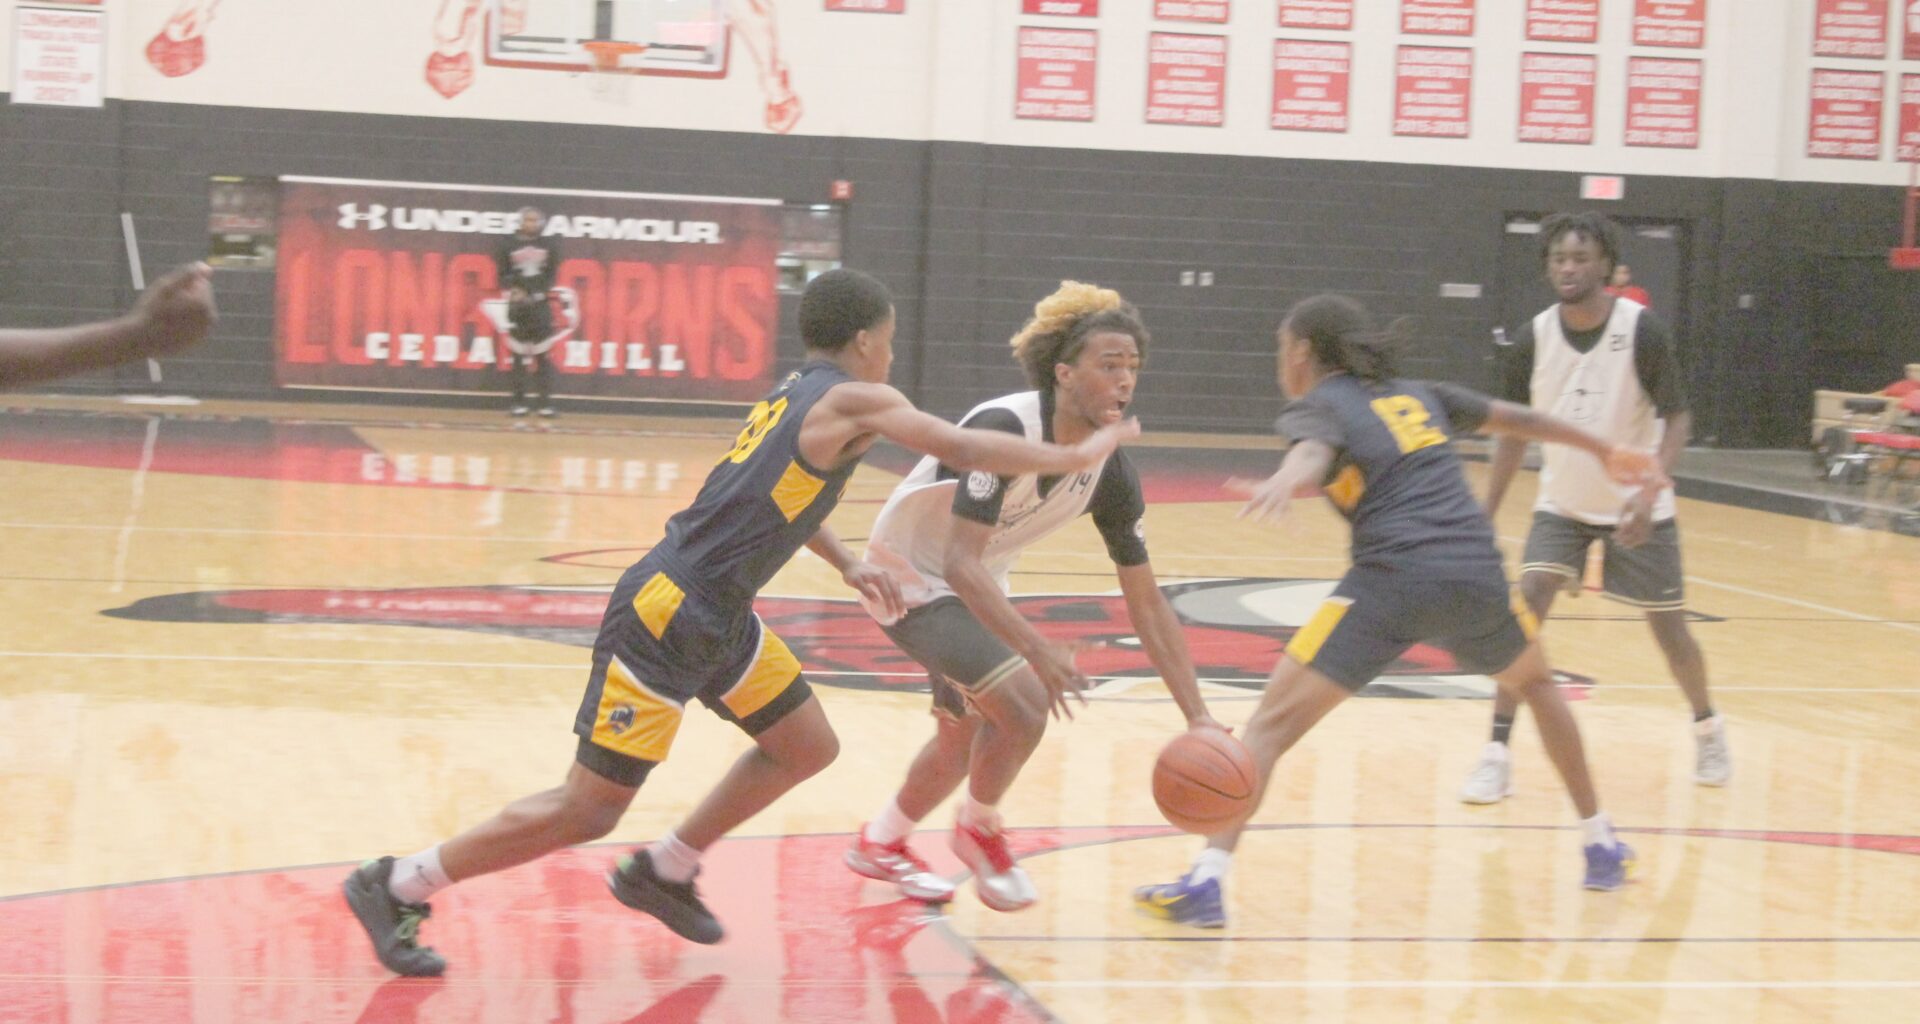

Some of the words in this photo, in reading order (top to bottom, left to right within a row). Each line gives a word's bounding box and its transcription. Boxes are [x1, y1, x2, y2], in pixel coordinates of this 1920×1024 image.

[541, 214, 722, 245] ARMOUR
[282, 249, 767, 382] LONGORNS
[365, 332, 533, 367] CEDA
[564, 340, 685, 371] HILL
